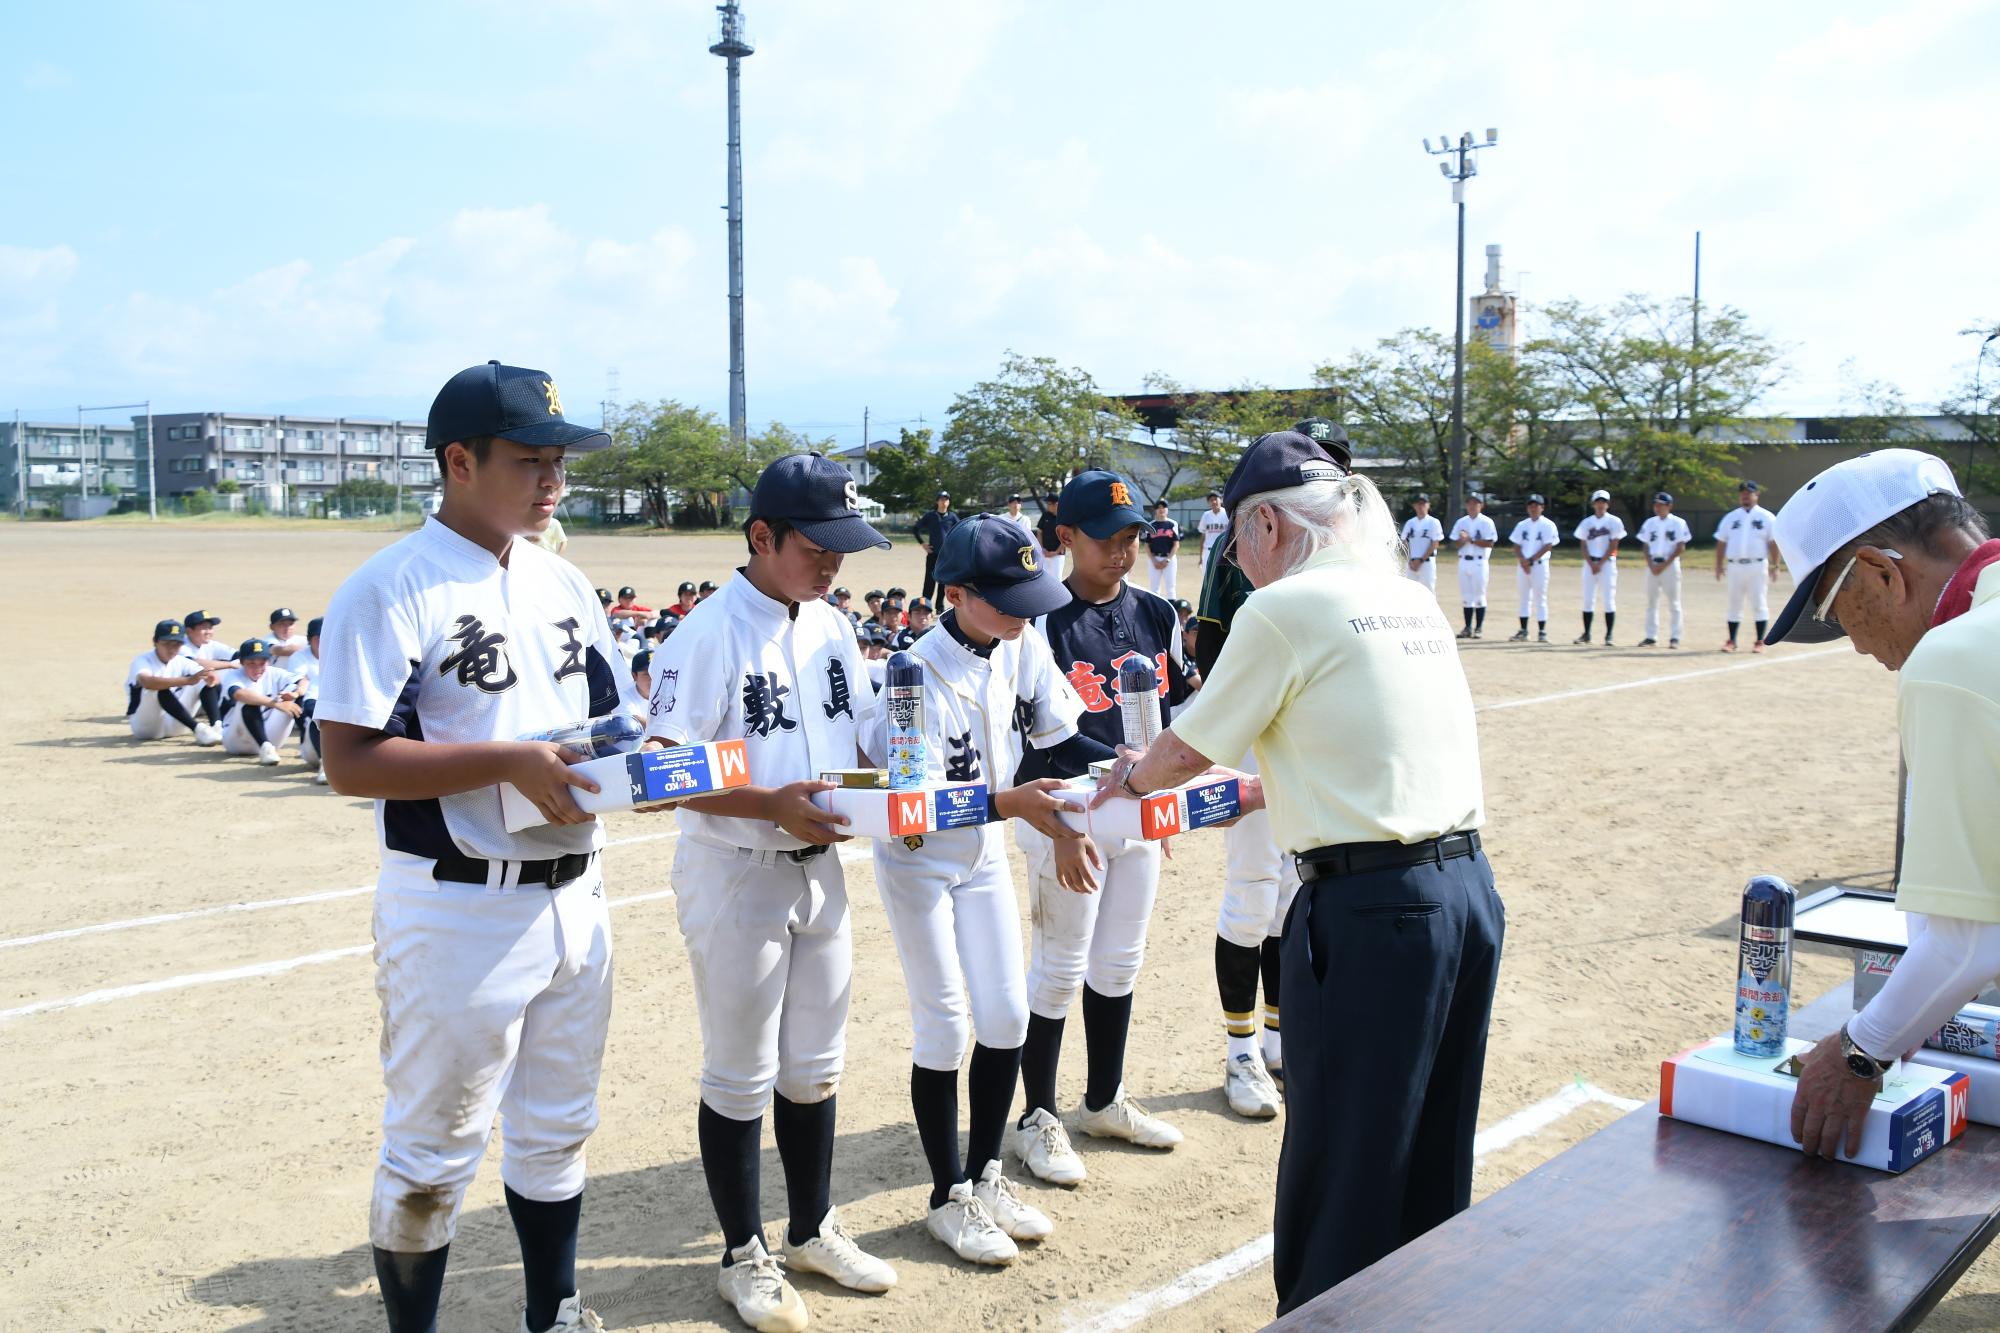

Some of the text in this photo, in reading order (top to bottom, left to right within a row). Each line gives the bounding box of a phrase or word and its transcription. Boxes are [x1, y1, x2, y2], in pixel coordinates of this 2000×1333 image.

[1348, 616, 1380, 634] THE
[1379, 615, 1426, 630] ROTARY
[1401, 640, 1426, 655] KAI
[888, 700, 920, 712] コールド
[722, 747, 746, 777] M
[669, 772, 692, 783] BALL
[952, 796, 971, 805] BALL
[1204, 793, 1222, 803] BALL
[901, 800, 923, 826] M
[1154, 803, 1176, 830] M
[1741, 941, 1786, 958] コールド
[1864, 951, 1883, 962] Italy
[1953, 1088, 1967, 1126] M
[1918, 1131, 1932, 1145] BALL
